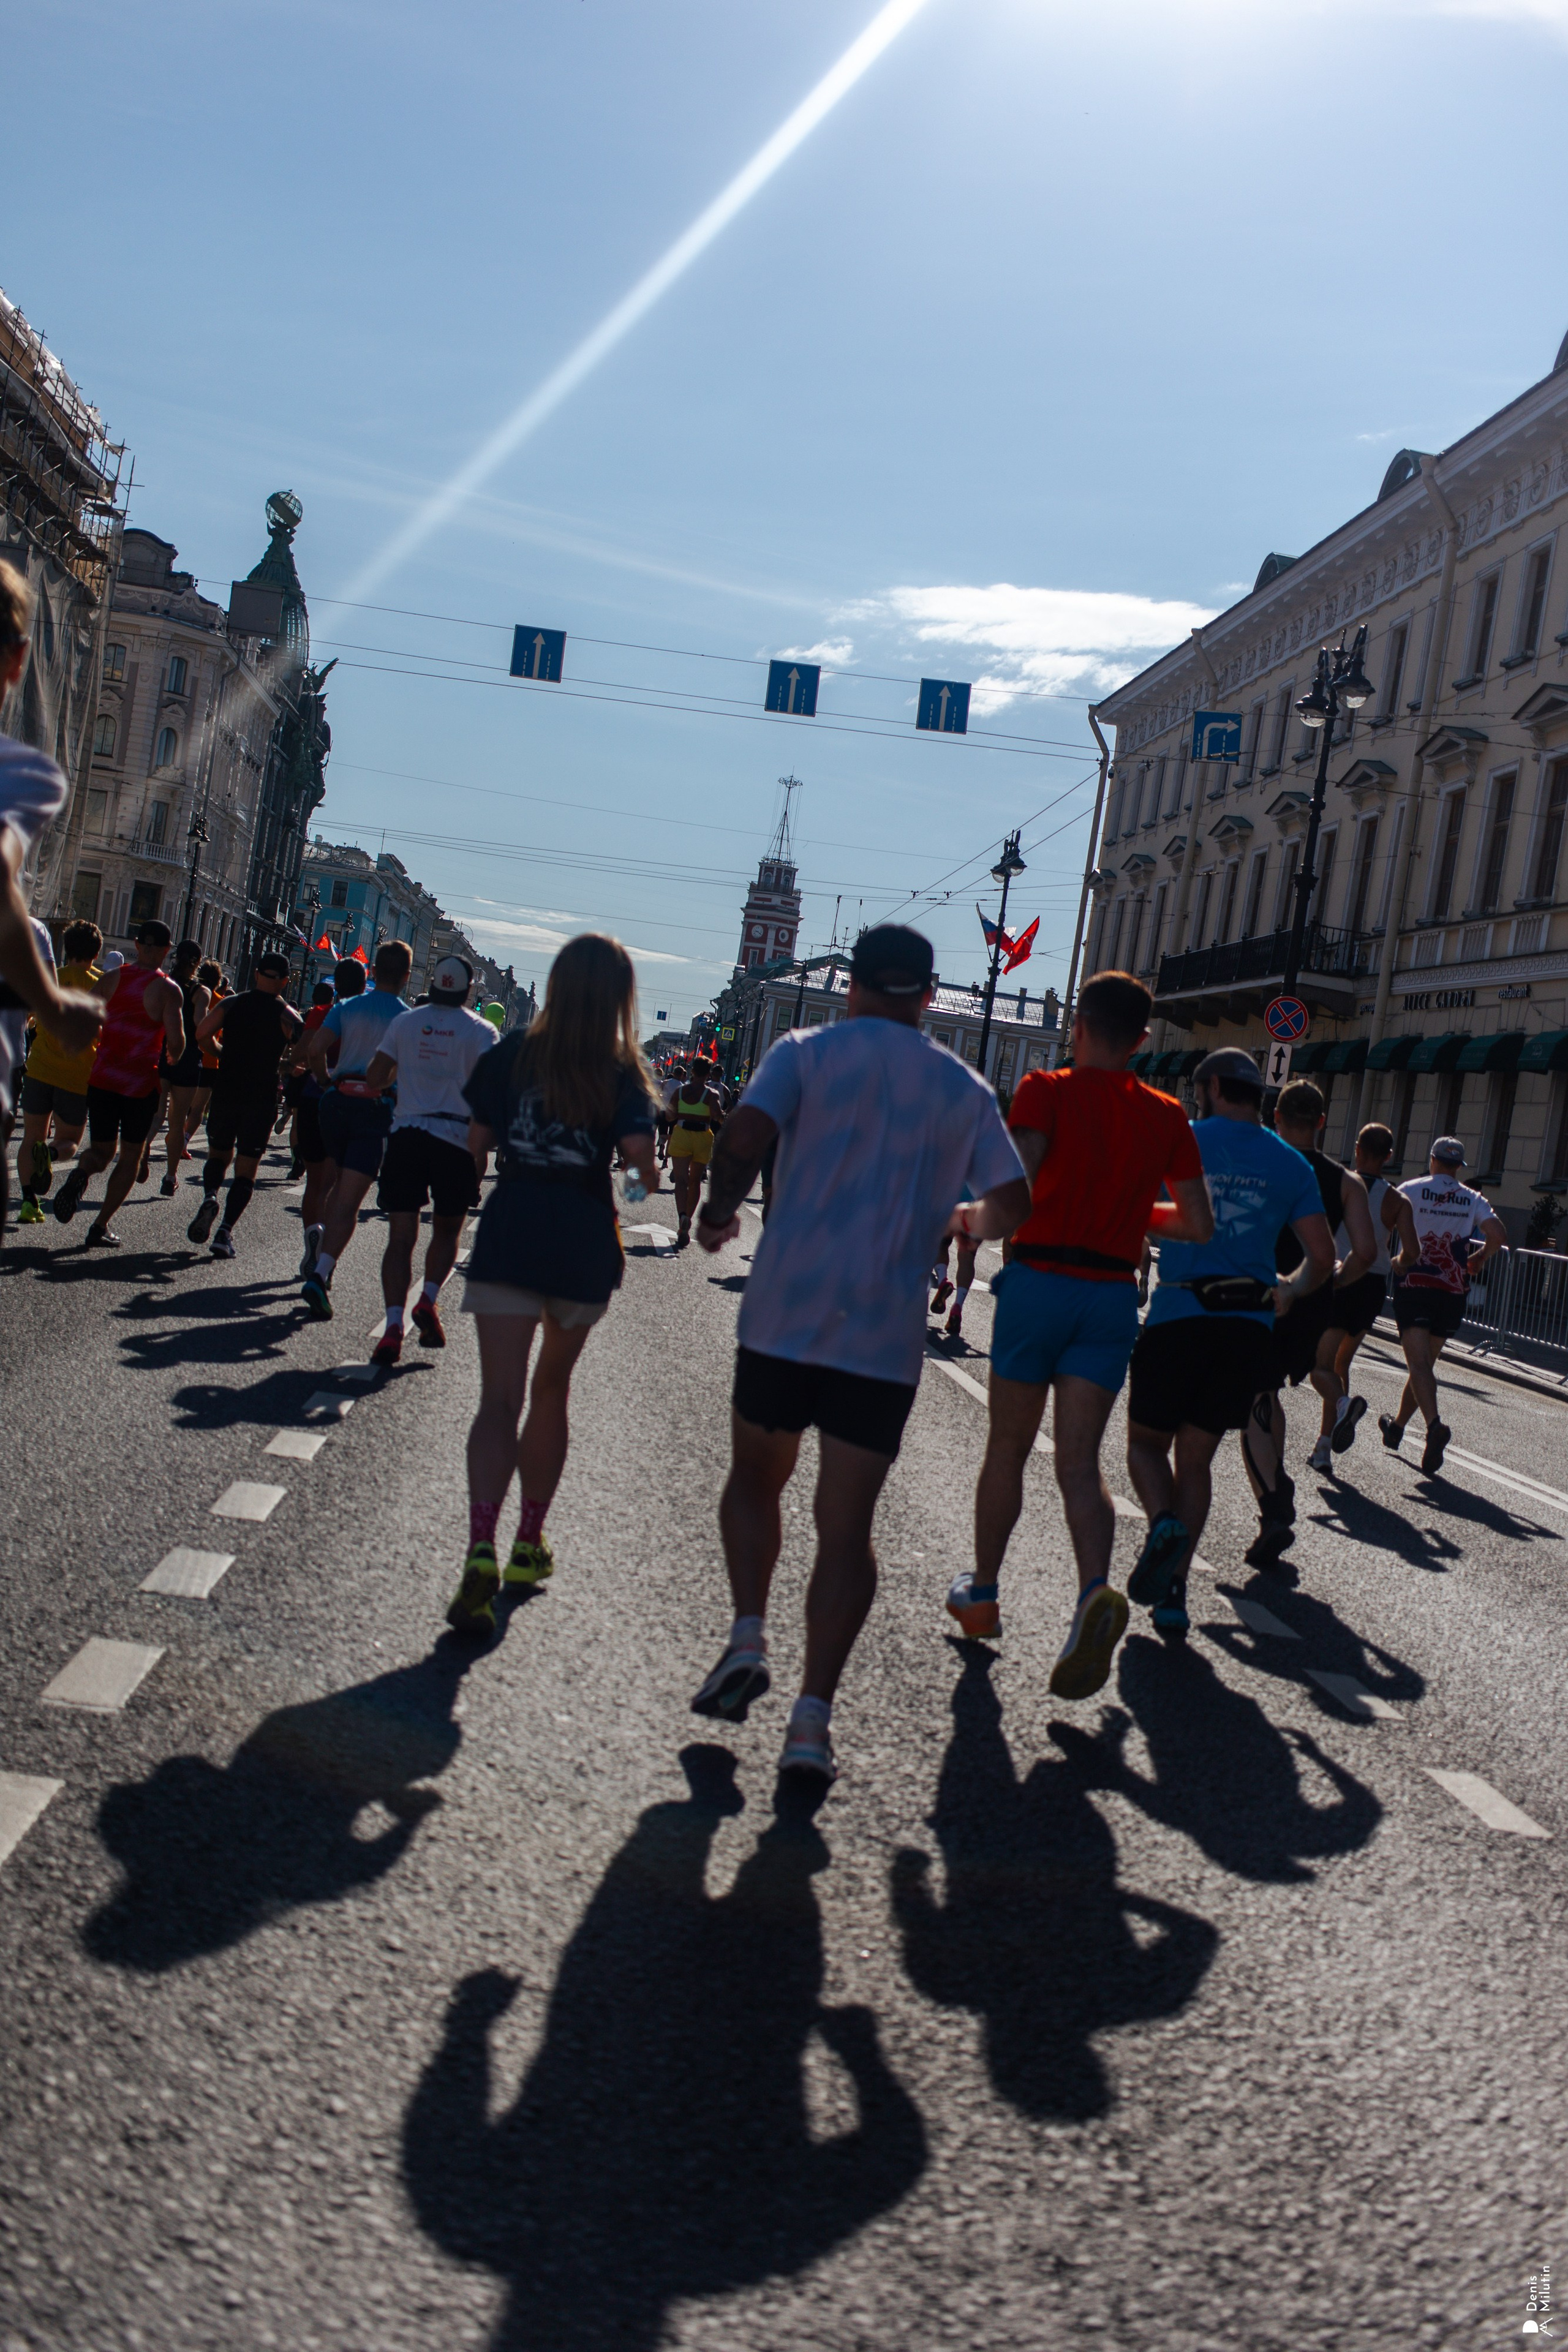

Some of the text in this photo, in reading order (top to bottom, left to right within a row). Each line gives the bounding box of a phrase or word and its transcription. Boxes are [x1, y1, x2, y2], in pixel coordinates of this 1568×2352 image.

[1498, 984, 1530, 998] restaurant
[1422, 1188, 1471, 1206] One Run
[1430, 1209, 1469, 1218] PETERSBURG
